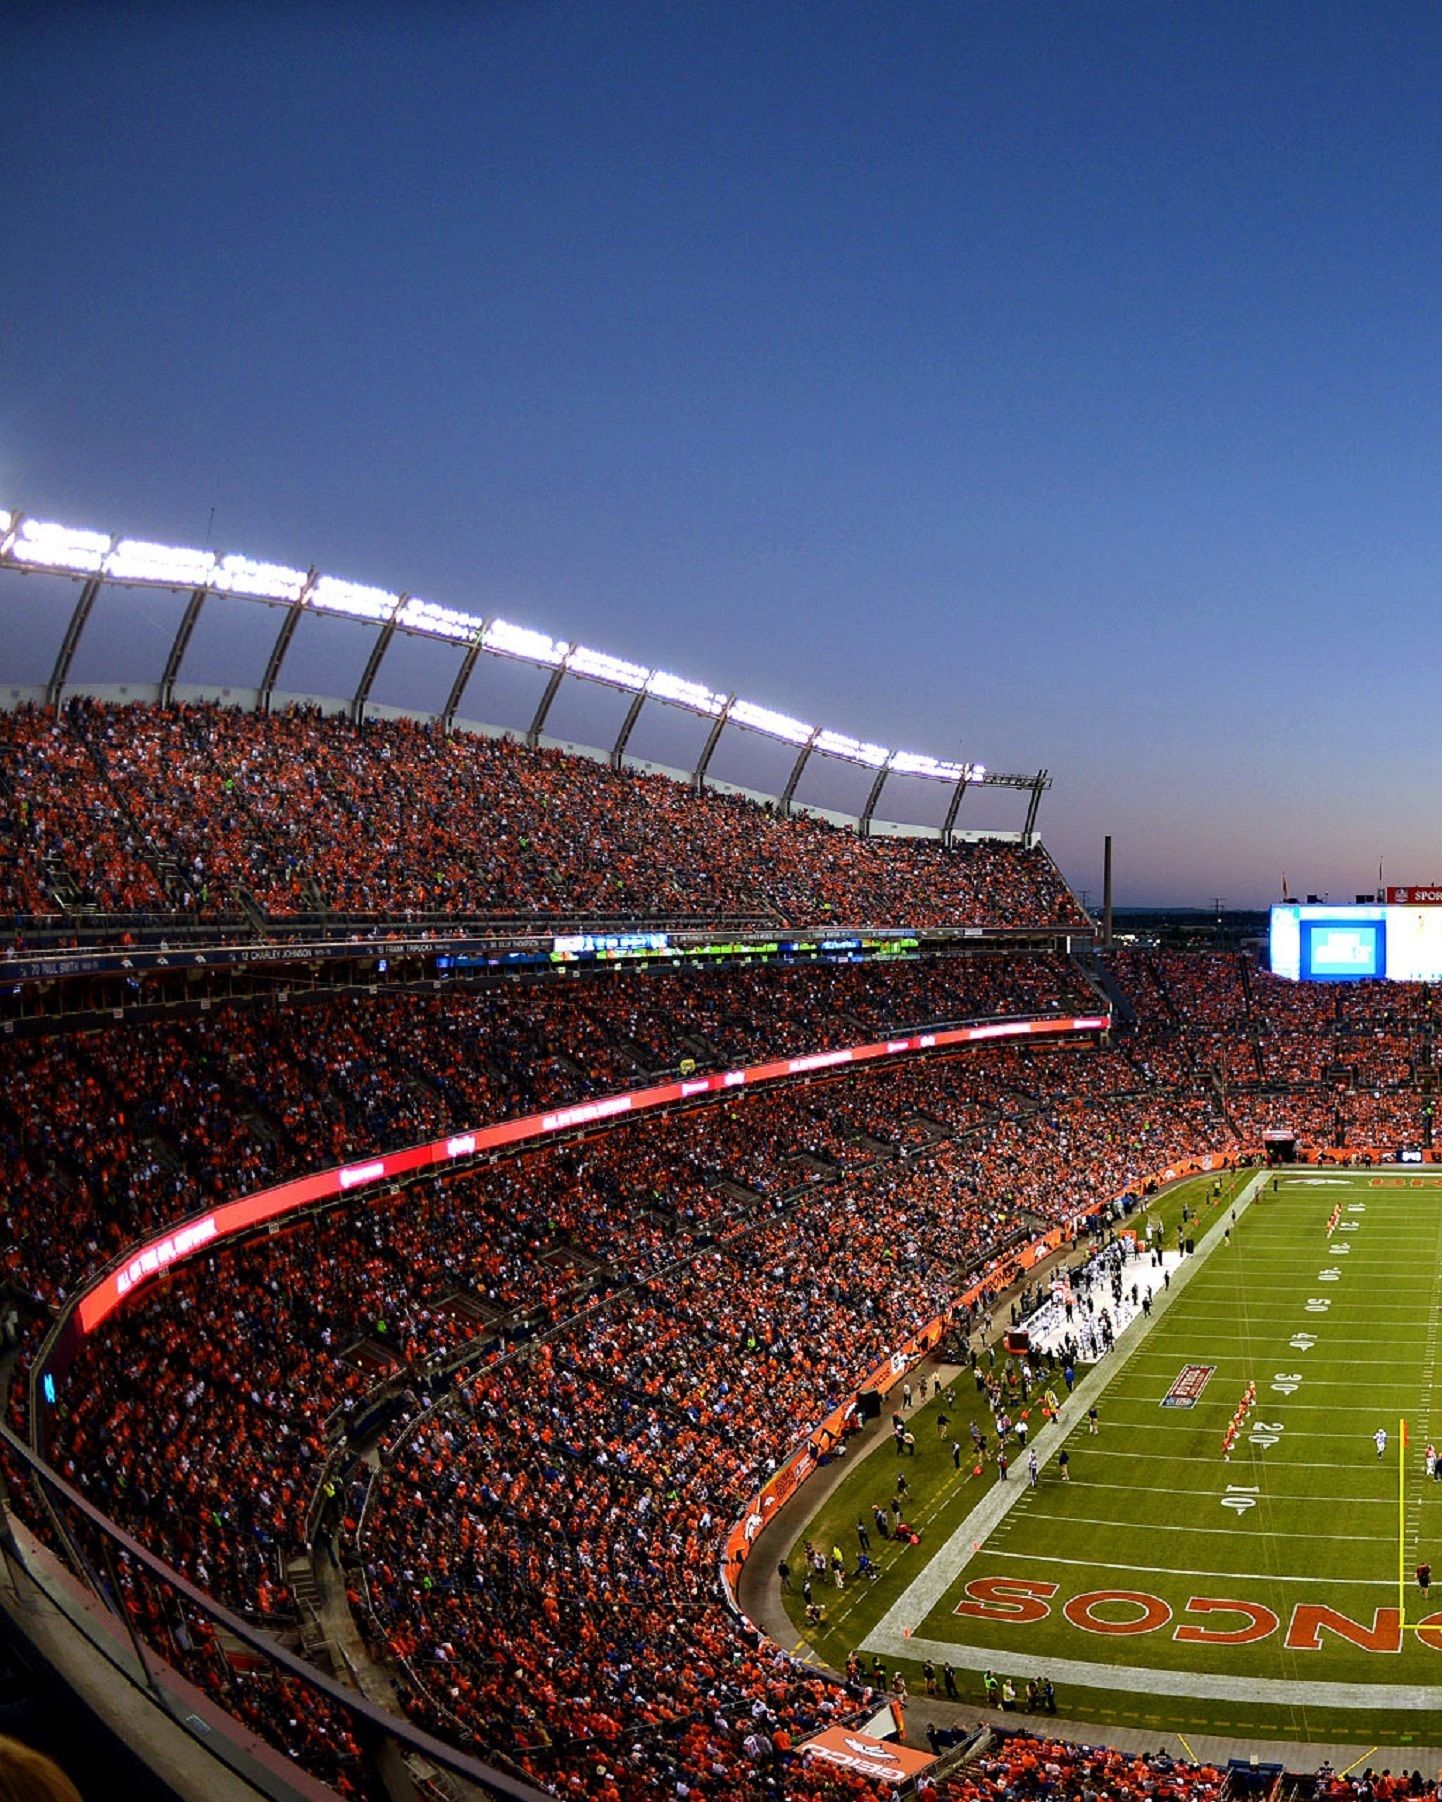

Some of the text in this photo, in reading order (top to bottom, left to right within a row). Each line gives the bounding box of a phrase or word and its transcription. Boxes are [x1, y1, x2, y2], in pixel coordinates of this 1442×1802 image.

[282, 948, 312, 959] JOHNSON
[1305, 1298, 1332, 1312] 50
[1290, 1333, 1318, 1349] 40
[1271, 1373, 1303, 1392] 30
[1248, 1421, 1285, 1447] 20
[1221, 1484, 1260, 1509] 10
[801, 1743, 906, 1781] GEICO
